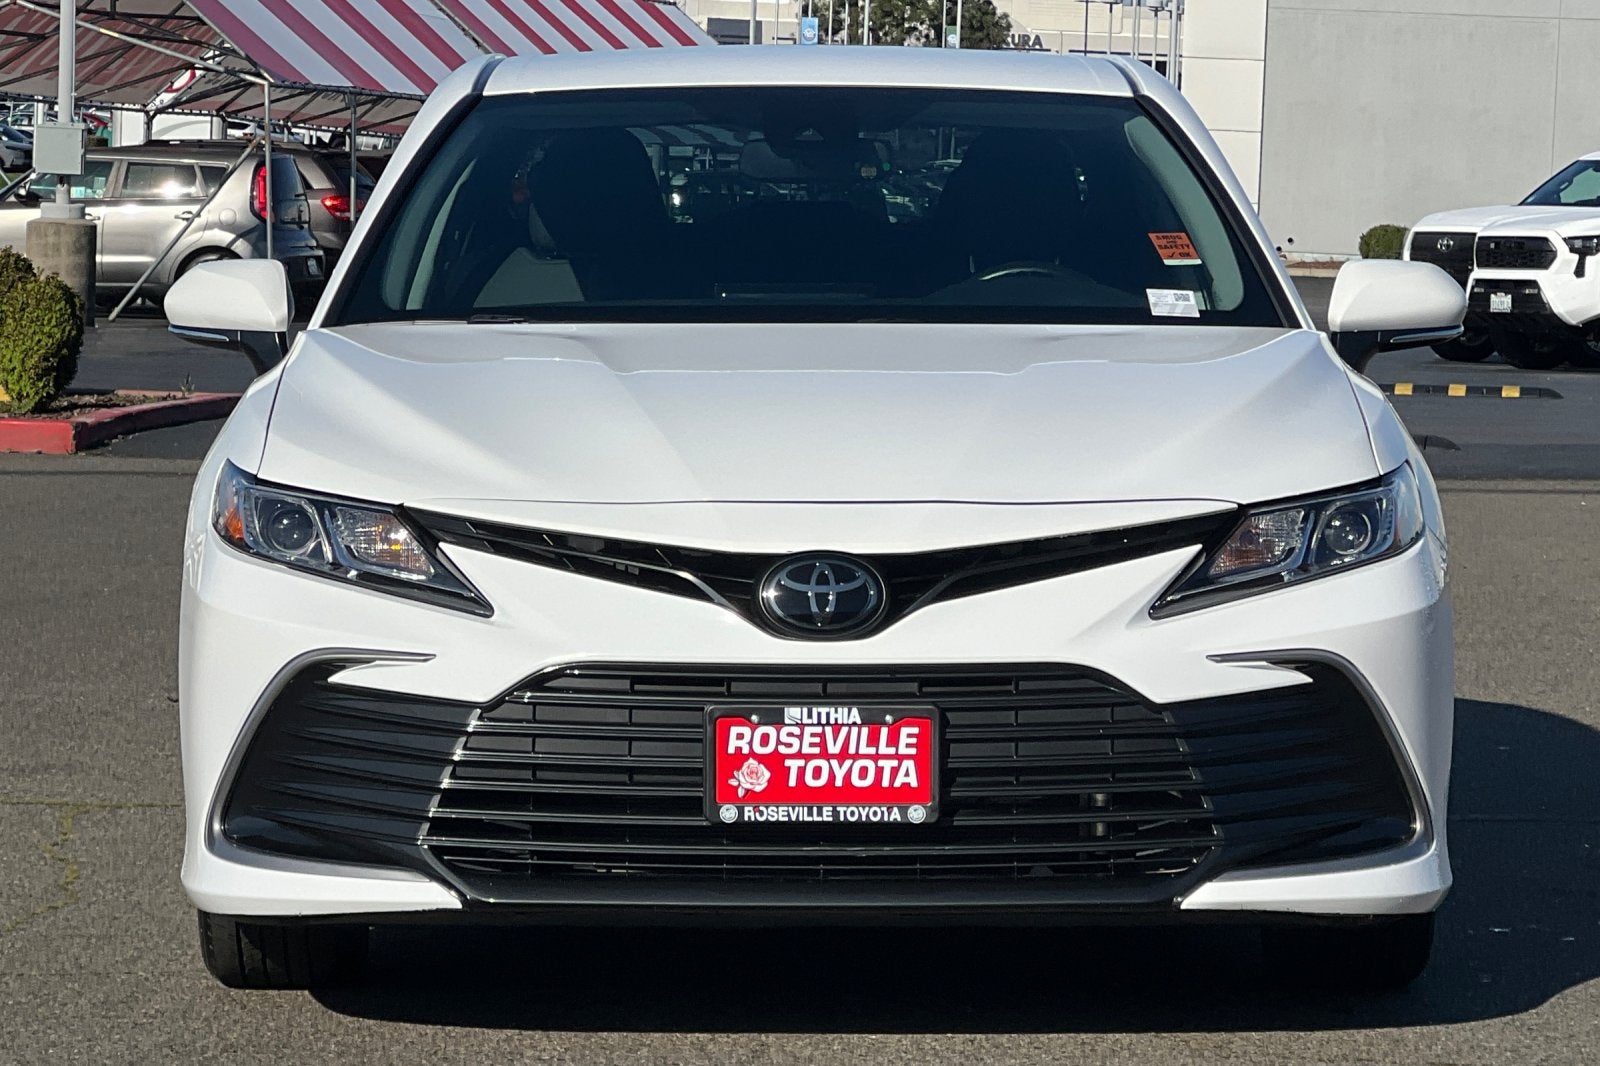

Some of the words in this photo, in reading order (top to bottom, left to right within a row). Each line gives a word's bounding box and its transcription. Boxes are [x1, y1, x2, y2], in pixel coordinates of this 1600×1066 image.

[801, 707, 862, 724] LITHIA
[727, 726, 920, 755] ROSEVILLE
[784, 759, 919, 788] TOYOTA
[744, 806, 833, 822] ROSEVILLE
[836, 806, 902, 822] TOYOTA
